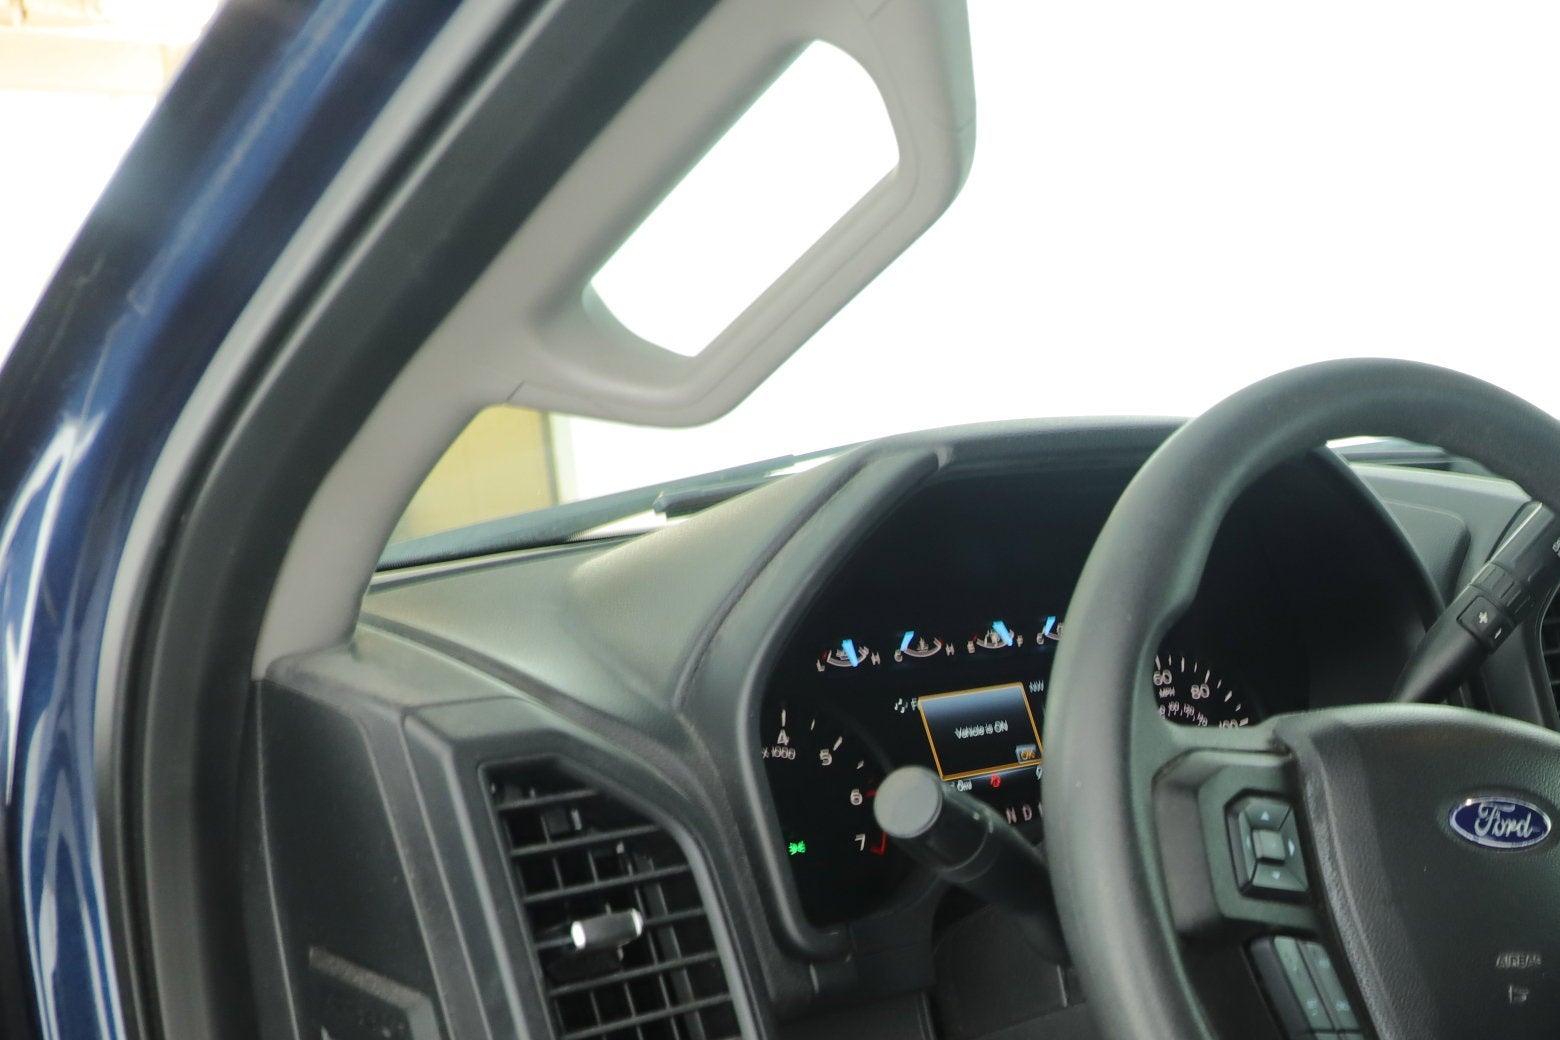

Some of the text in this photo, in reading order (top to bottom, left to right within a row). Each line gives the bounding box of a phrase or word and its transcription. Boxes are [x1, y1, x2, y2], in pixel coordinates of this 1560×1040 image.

[1153, 669, 1172, 686] 60
[1190, 683, 1210, 700] 80
[777, 729, 790, 746] 4
[954, 725, 985, 739] Vehicle
[994, 719, 1009, 734] ON
[819, 748, 833, 766] 5
[850, 788, 863, 806] 6
[1022, 804, 1033, 821] D
[1474, 803, 1533, 838] Ford
[855, 833, 866, 851] 7
